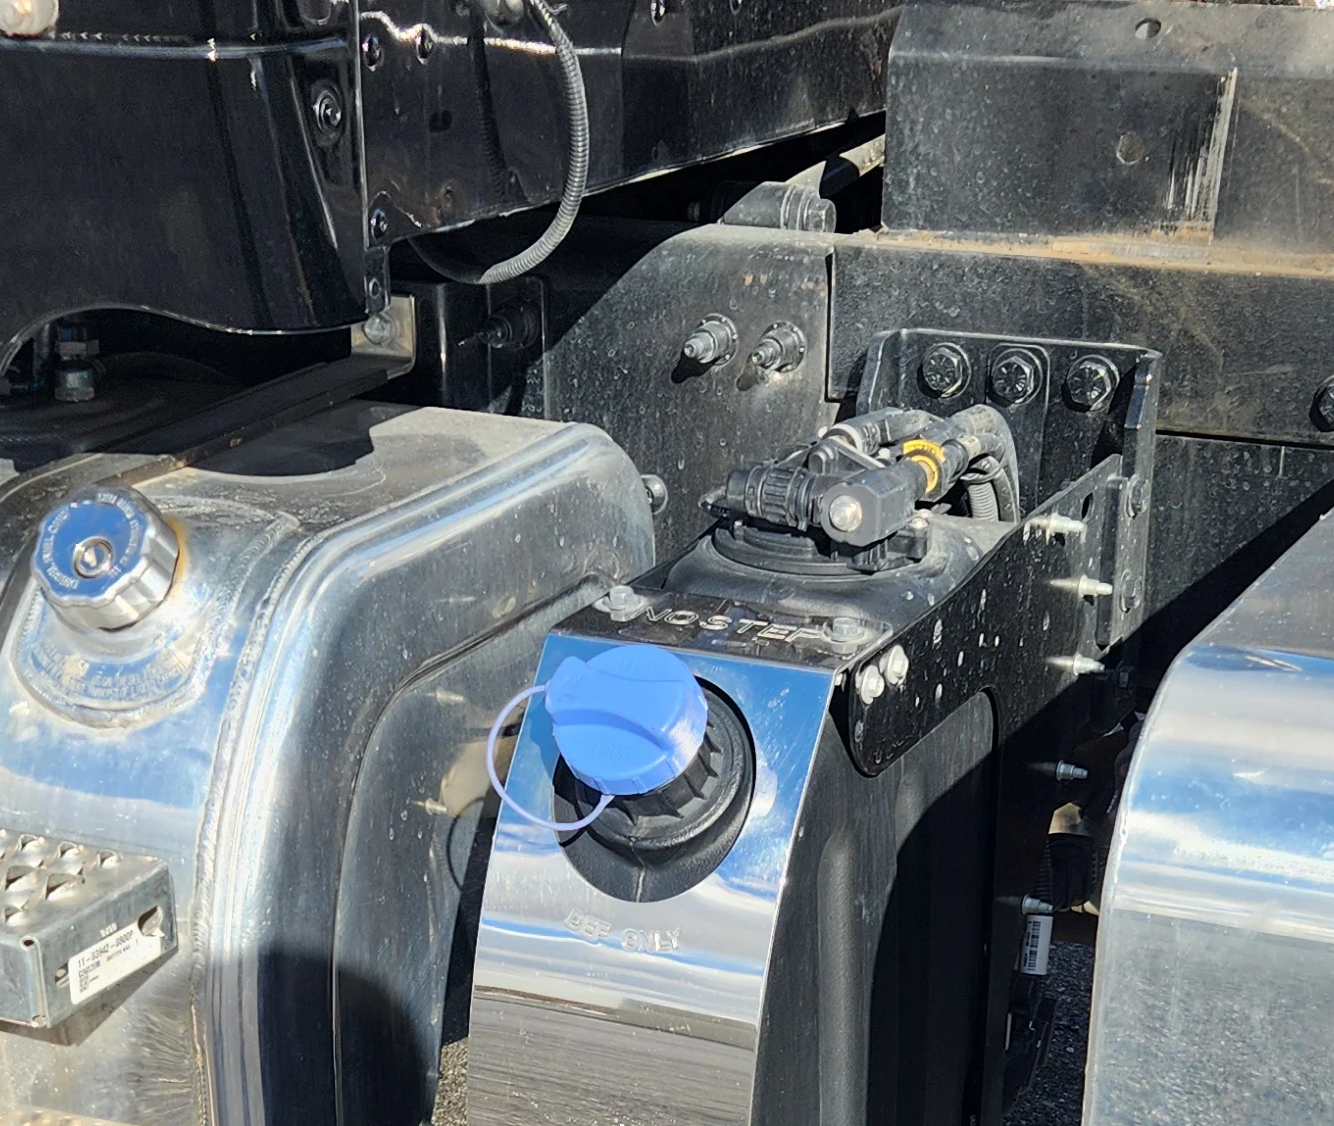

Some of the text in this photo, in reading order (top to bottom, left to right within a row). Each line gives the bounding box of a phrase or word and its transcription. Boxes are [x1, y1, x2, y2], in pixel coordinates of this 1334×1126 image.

[630, 605, 825, 643] NO STEP
[564, 907, 682, 953] DEF ONLY
